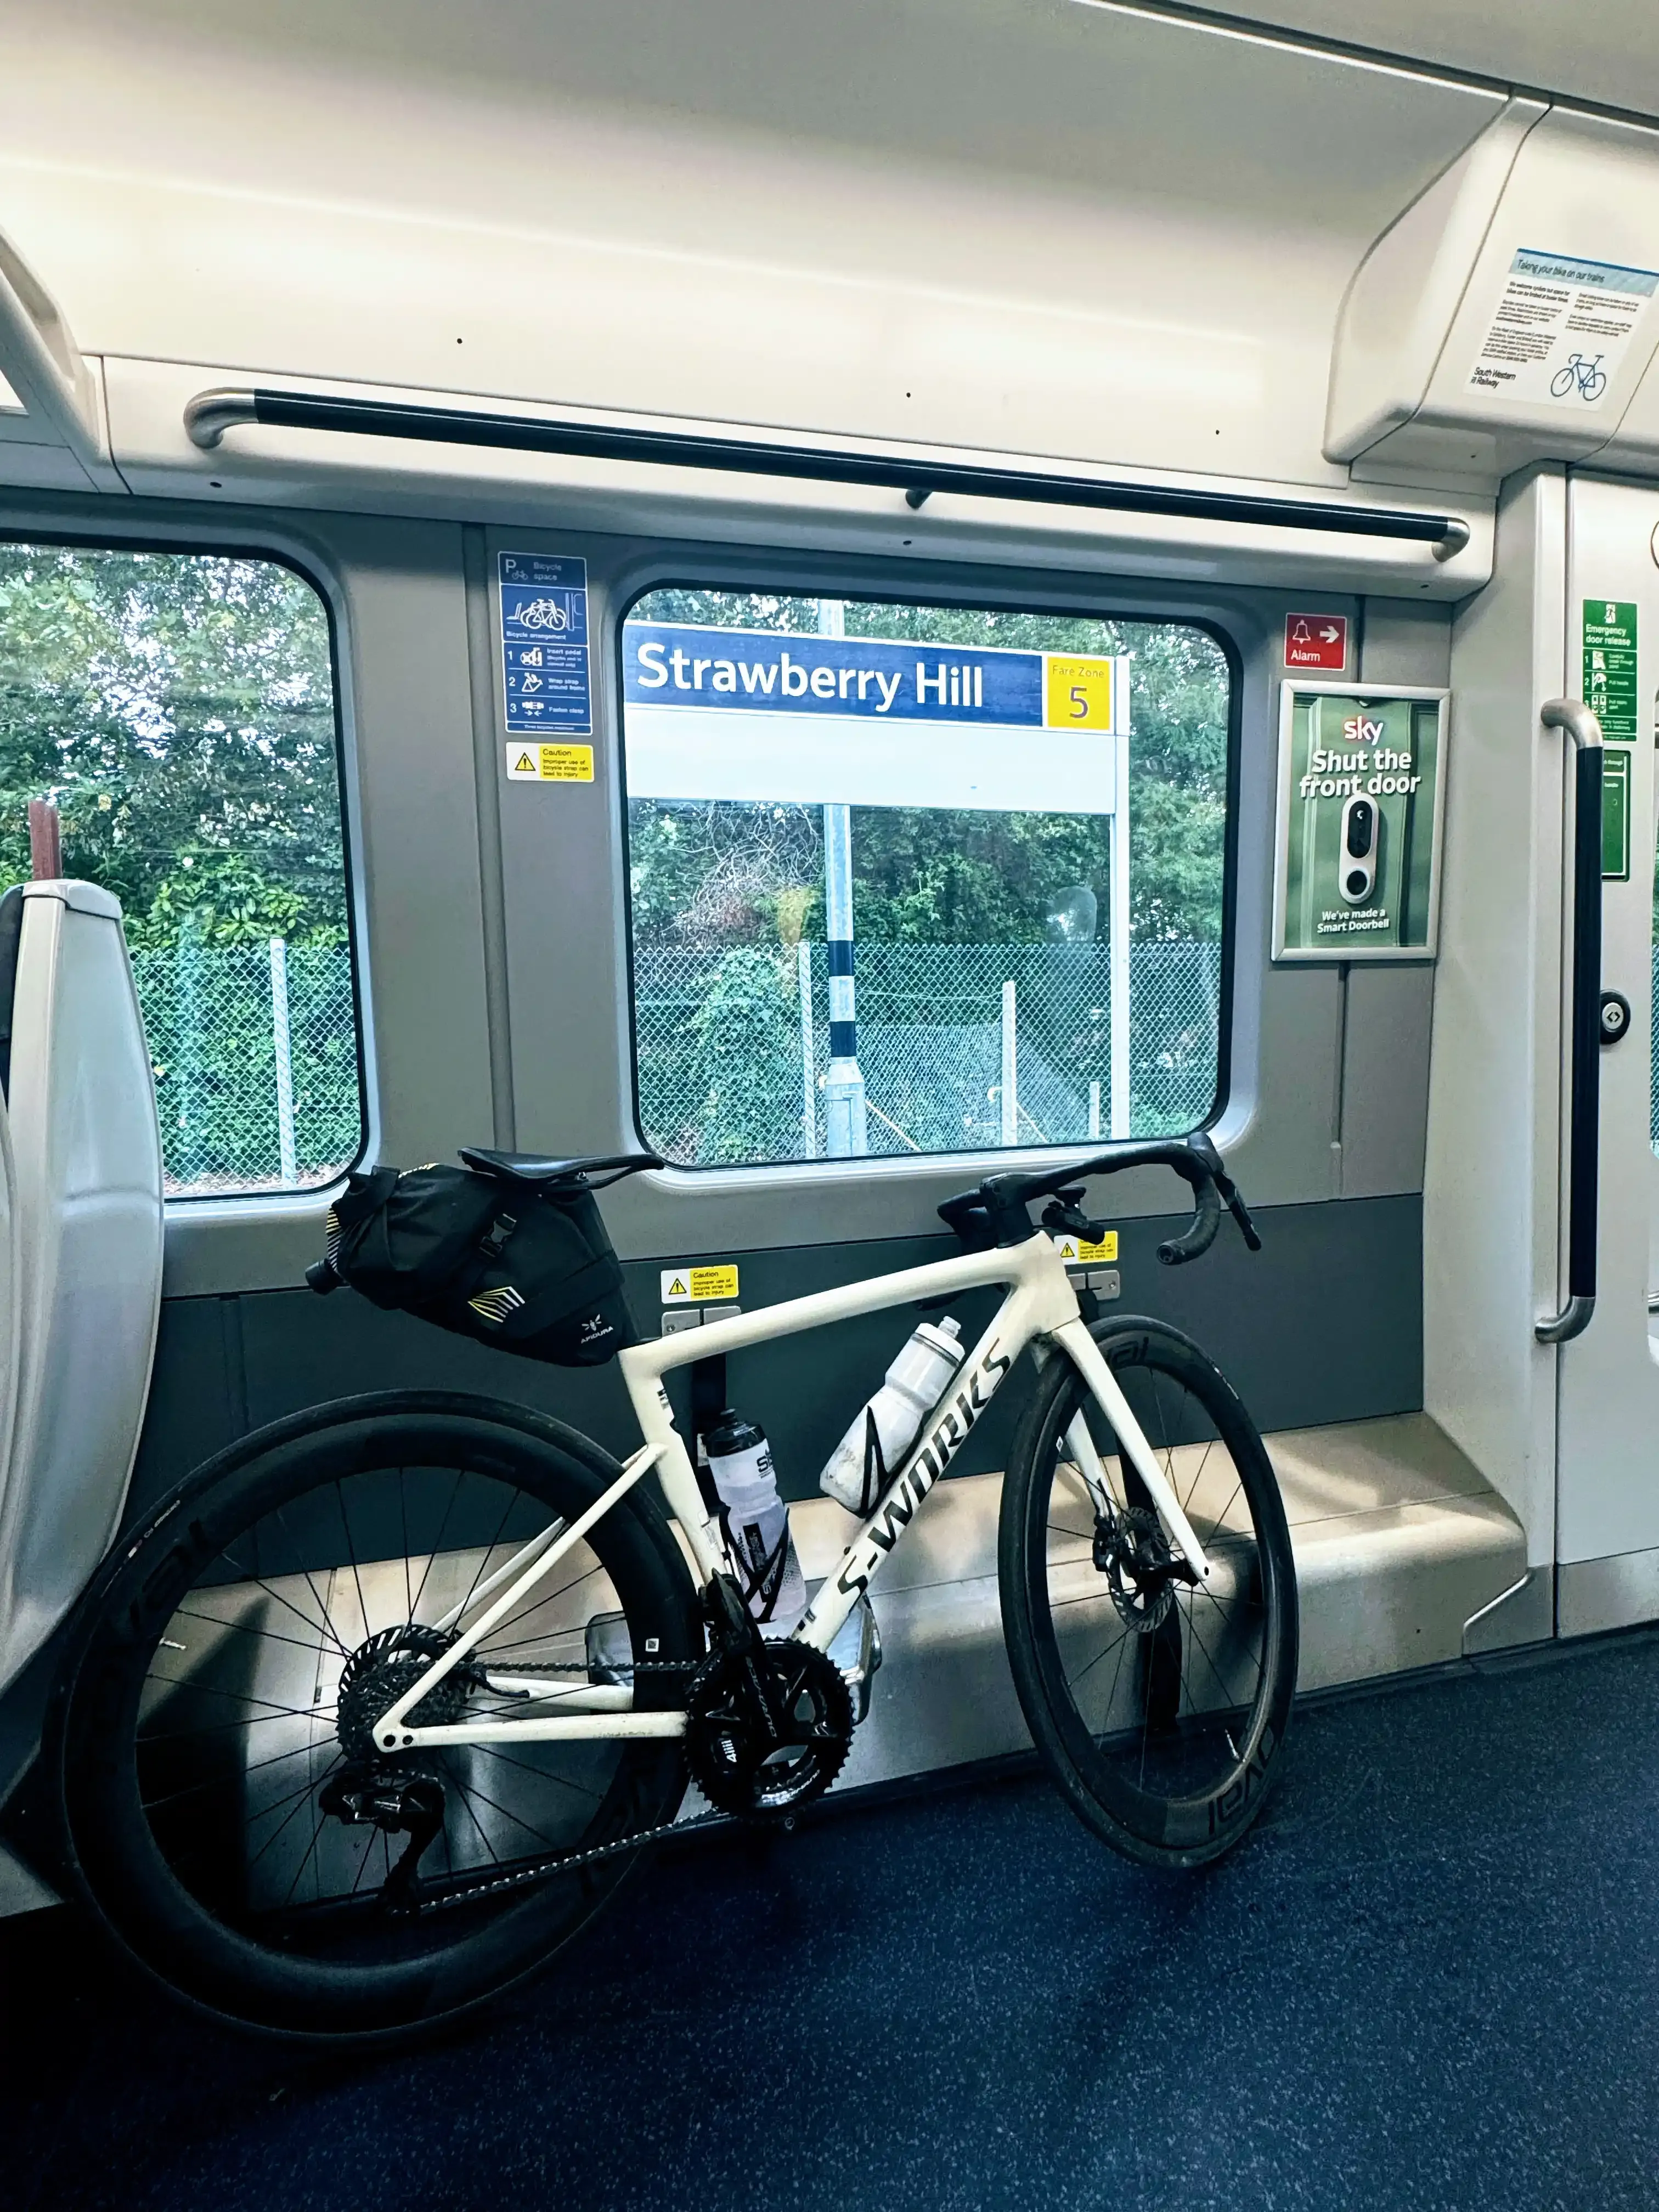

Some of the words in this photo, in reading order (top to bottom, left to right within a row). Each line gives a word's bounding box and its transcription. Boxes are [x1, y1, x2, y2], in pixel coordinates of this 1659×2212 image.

[1537, 265, 1553, 274] your
[1474, 367, 1492, 377] South
[1492, 369, 1516, 381] Western
[1476, 376, 1499, 388] Railway
[505, 558, 517, 574] P
[533, 562, 562, 572] Bicycle
[1585, 623, 1627, 637] Emergency
[1585, 634, 1603, 644] door
[1604, 636, 1631, 646] release
[507, 650, 513, 661] 1
[1290, 648, 1321, 662] Alarm
[1584, 655, 1589, 663] 1
[637, 642, 902, 712] Strawberry
[916, 661, 983, 708] Hill
[1052, 664, 1075, 678] Fare
[1078, 665, 1105, 679] Zone
[509, 676, 516, 686] 2
[1584, 677, 1590, 686] 2
[510, 703, 517, 713] 3
[1069, 687, 1089, 719] 5
[1344, 715, 1383, 746] sky
[1311, 749, 1369, 773] Shut
[1373, 747, 1412, 771] the
[1299, 775, 1362, 798] front
[1367, 772, 1421, 797] door
[1321, 910, 1349, 922] We've
[1351, 909, 1378, 919] made
[1379, 910, 1386, 918] a
[1317, 922, 1347, 935] Smart
[1348, 918, 1390, 932] Doorbell
[837, 1337, 1011, 1594] S-WORKS
